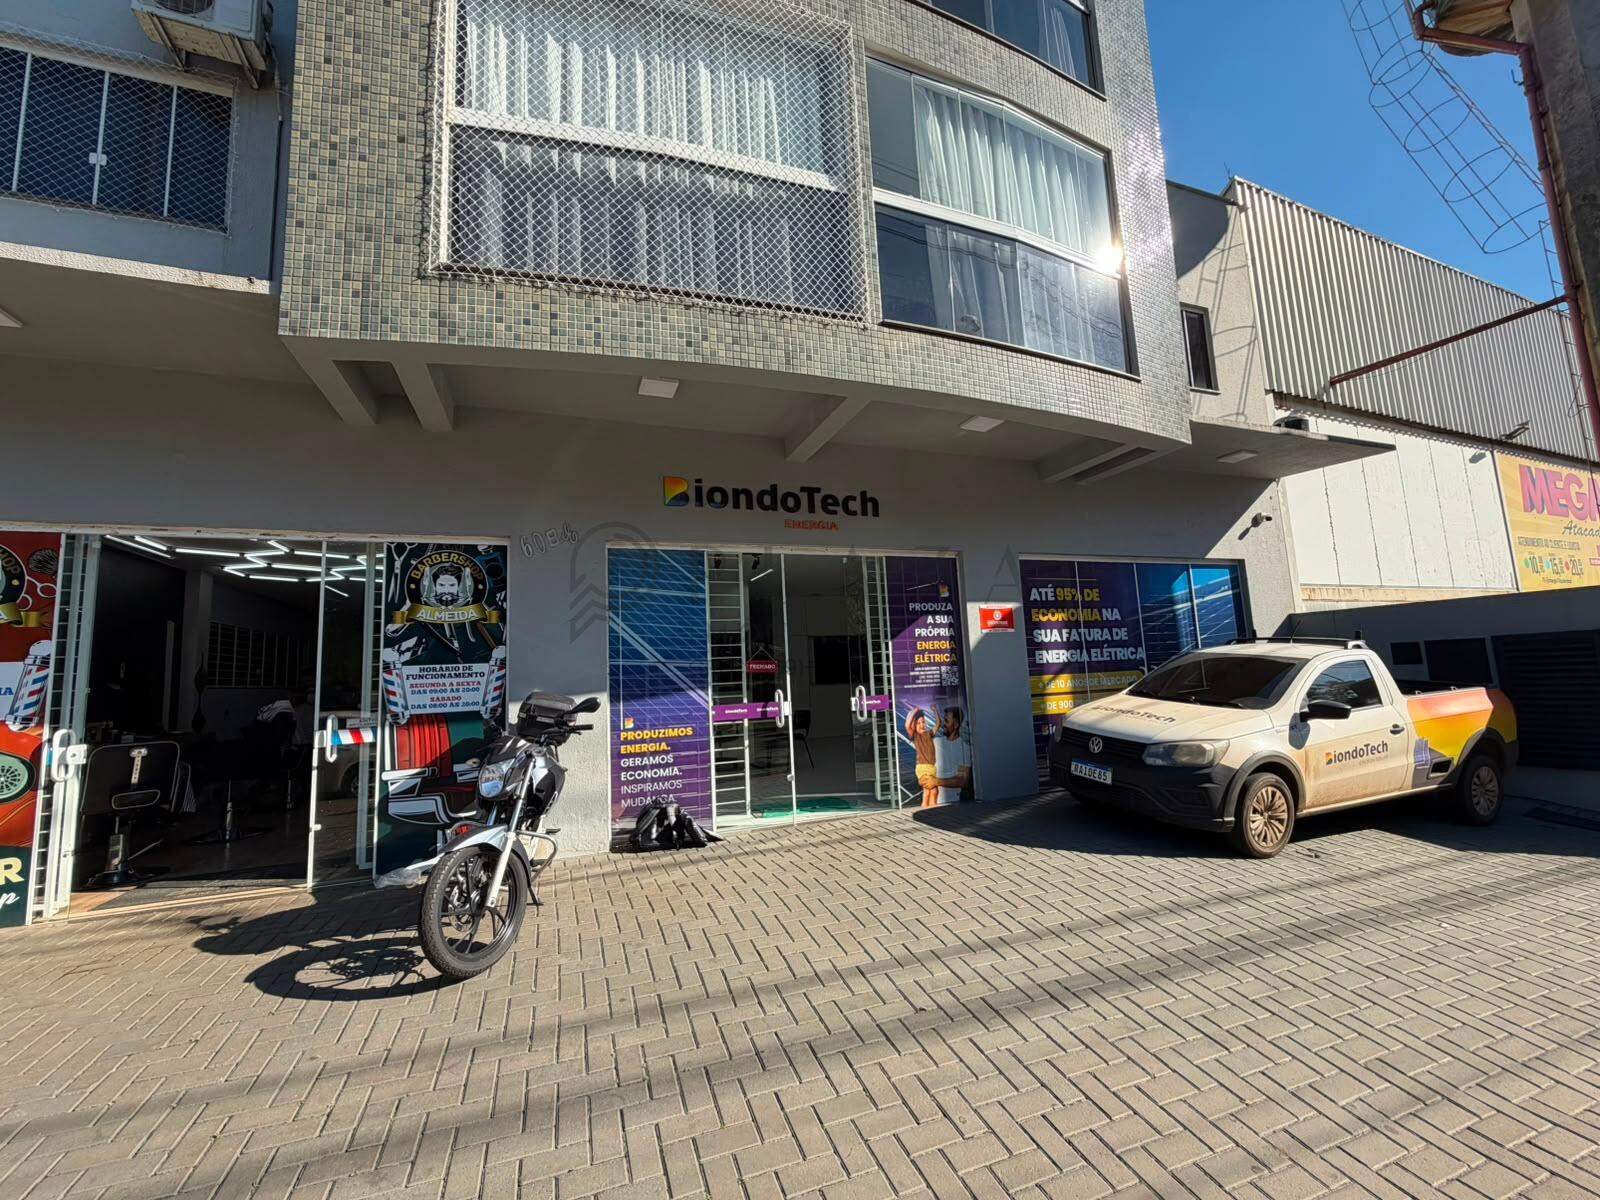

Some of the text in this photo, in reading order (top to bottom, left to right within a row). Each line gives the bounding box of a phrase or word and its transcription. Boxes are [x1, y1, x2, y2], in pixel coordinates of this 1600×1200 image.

[663, 476, 880, 517] BiondoTech
[784, 519, 838, 531] ENERGIA
[411, 552, 485, 581] BARBERSHOP
[1030, 584, 1100, 600] ATÉ 95% DE
[909, 602, 953, 611] PRODUZA
[416, 609, 477, 621] ALMEIDA
[926, 615, 953, 624] A SUA
[1031, 608, 1121, 622] ECONOMIA NA
[915, 625, 955, 637] PRÓPRIA
[1033, 627, 1128, 642] SUA FATURA DE
[917, 640, 956, 650] ENERGIA
[915, 652, 957, 664] ELÉTRICA
[1035, 644, 1147, 664] ENERGIA ELÉTRICA
[406, 671, 485, 680] FUNCIONAMENTO
[1046, 680, 1056, 688] DE
[1057, 680, 1065, 688] 10
[411, 702, 427, 710] DAS
[1046, 702, 1057, 710] DE
[620, 727, 694, 741] PRODUZIMOS
[620, 742, 671, 754] ENERGIA.
[1325, 740, 1389, 766] BiondoTech
[620, 755, 674, 768] GERAMOS
[621, 767, 682, 781] ECONOMIA.
[621, 780, 682, 795] INSPIRAMOS
